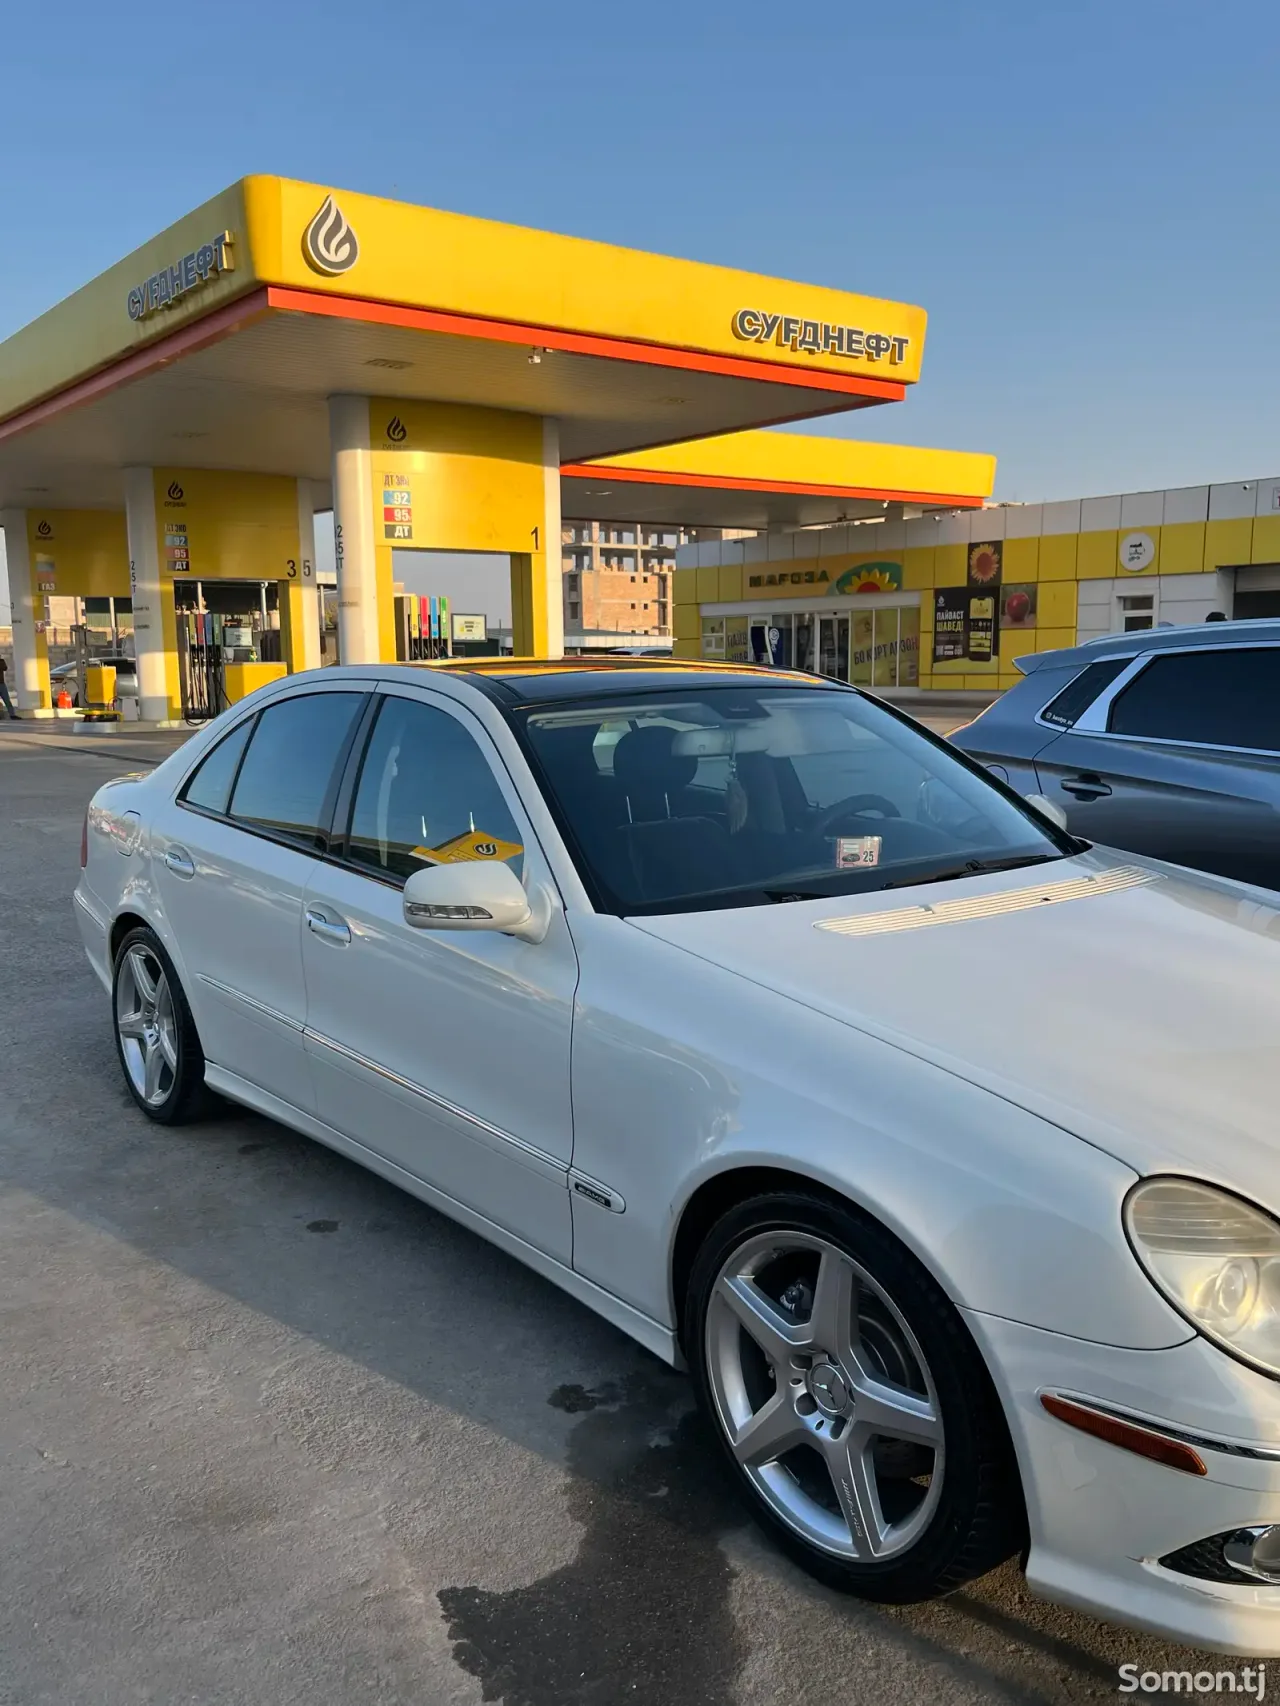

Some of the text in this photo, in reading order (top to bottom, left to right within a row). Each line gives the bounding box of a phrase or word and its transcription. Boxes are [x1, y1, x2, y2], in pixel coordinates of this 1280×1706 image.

[393, 492, 409, 505] 92
[394, 509, 410, 521] 95
[394, 525, 409, 537] ДТ
[173, 536, 186, 546] 92
[530, 526, 539, 550] 1
[174, 549, 187, 558] 95
[175, 561, 187, 570] ДТ
[286, 560, 297, 578] 3
[303, 559, 311, 577] 5
[863, 850, 874, 862] 25
